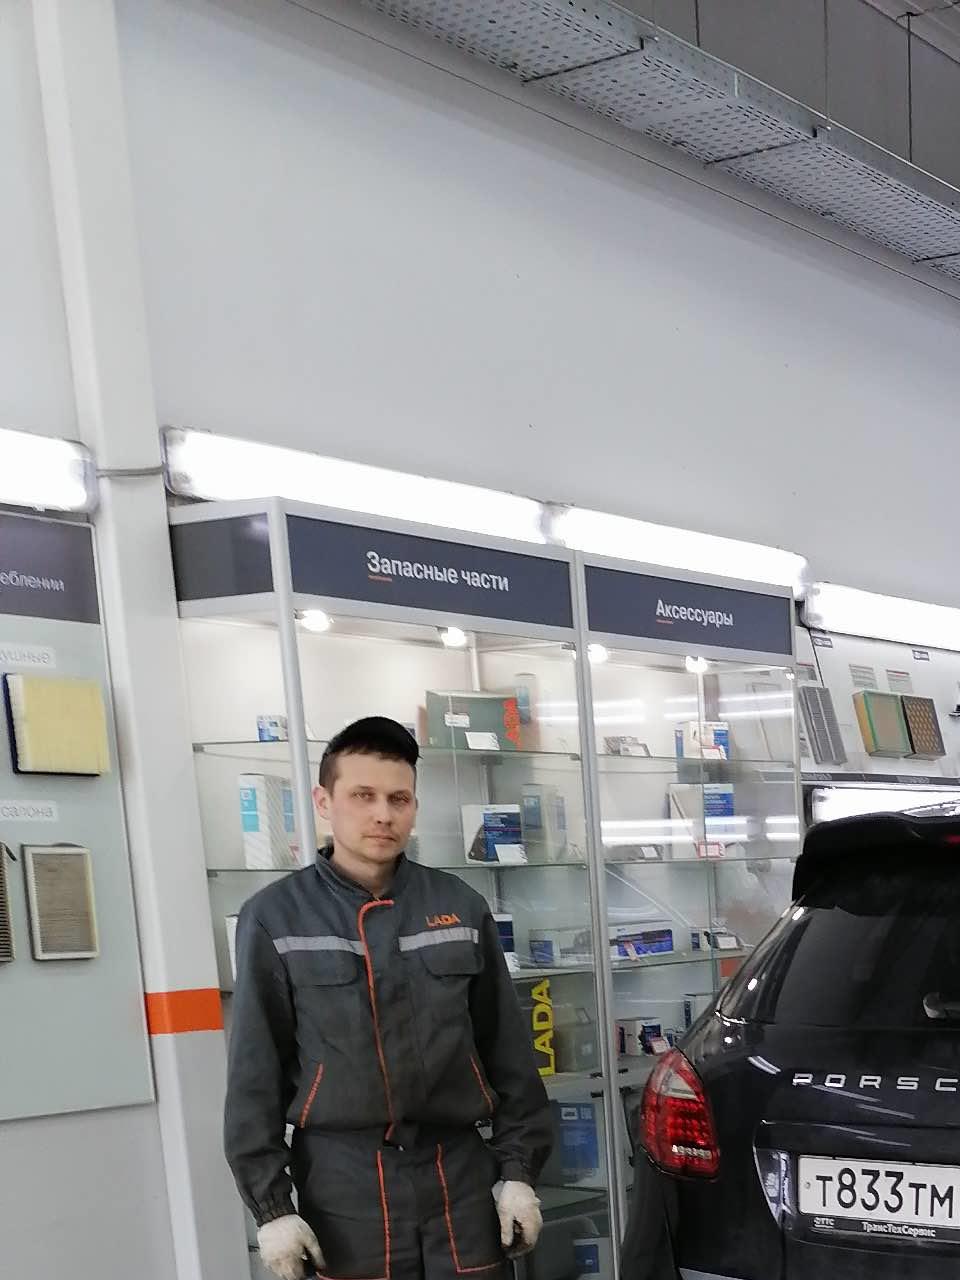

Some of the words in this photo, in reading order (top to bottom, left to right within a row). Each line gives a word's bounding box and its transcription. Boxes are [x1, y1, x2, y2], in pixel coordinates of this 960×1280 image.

[366, 550, 459, 586] Запасные
[461, 568, 509, 592] части
[655, 599, 734, 627] Аксессуары
[425, 913, 461, 928] LADA
[531, 977, 556, 1078] LADA
[816, 1168, 954, 1219] Т833ТМ
[861, 1221, 936, 1238] ТрансТехСервис
